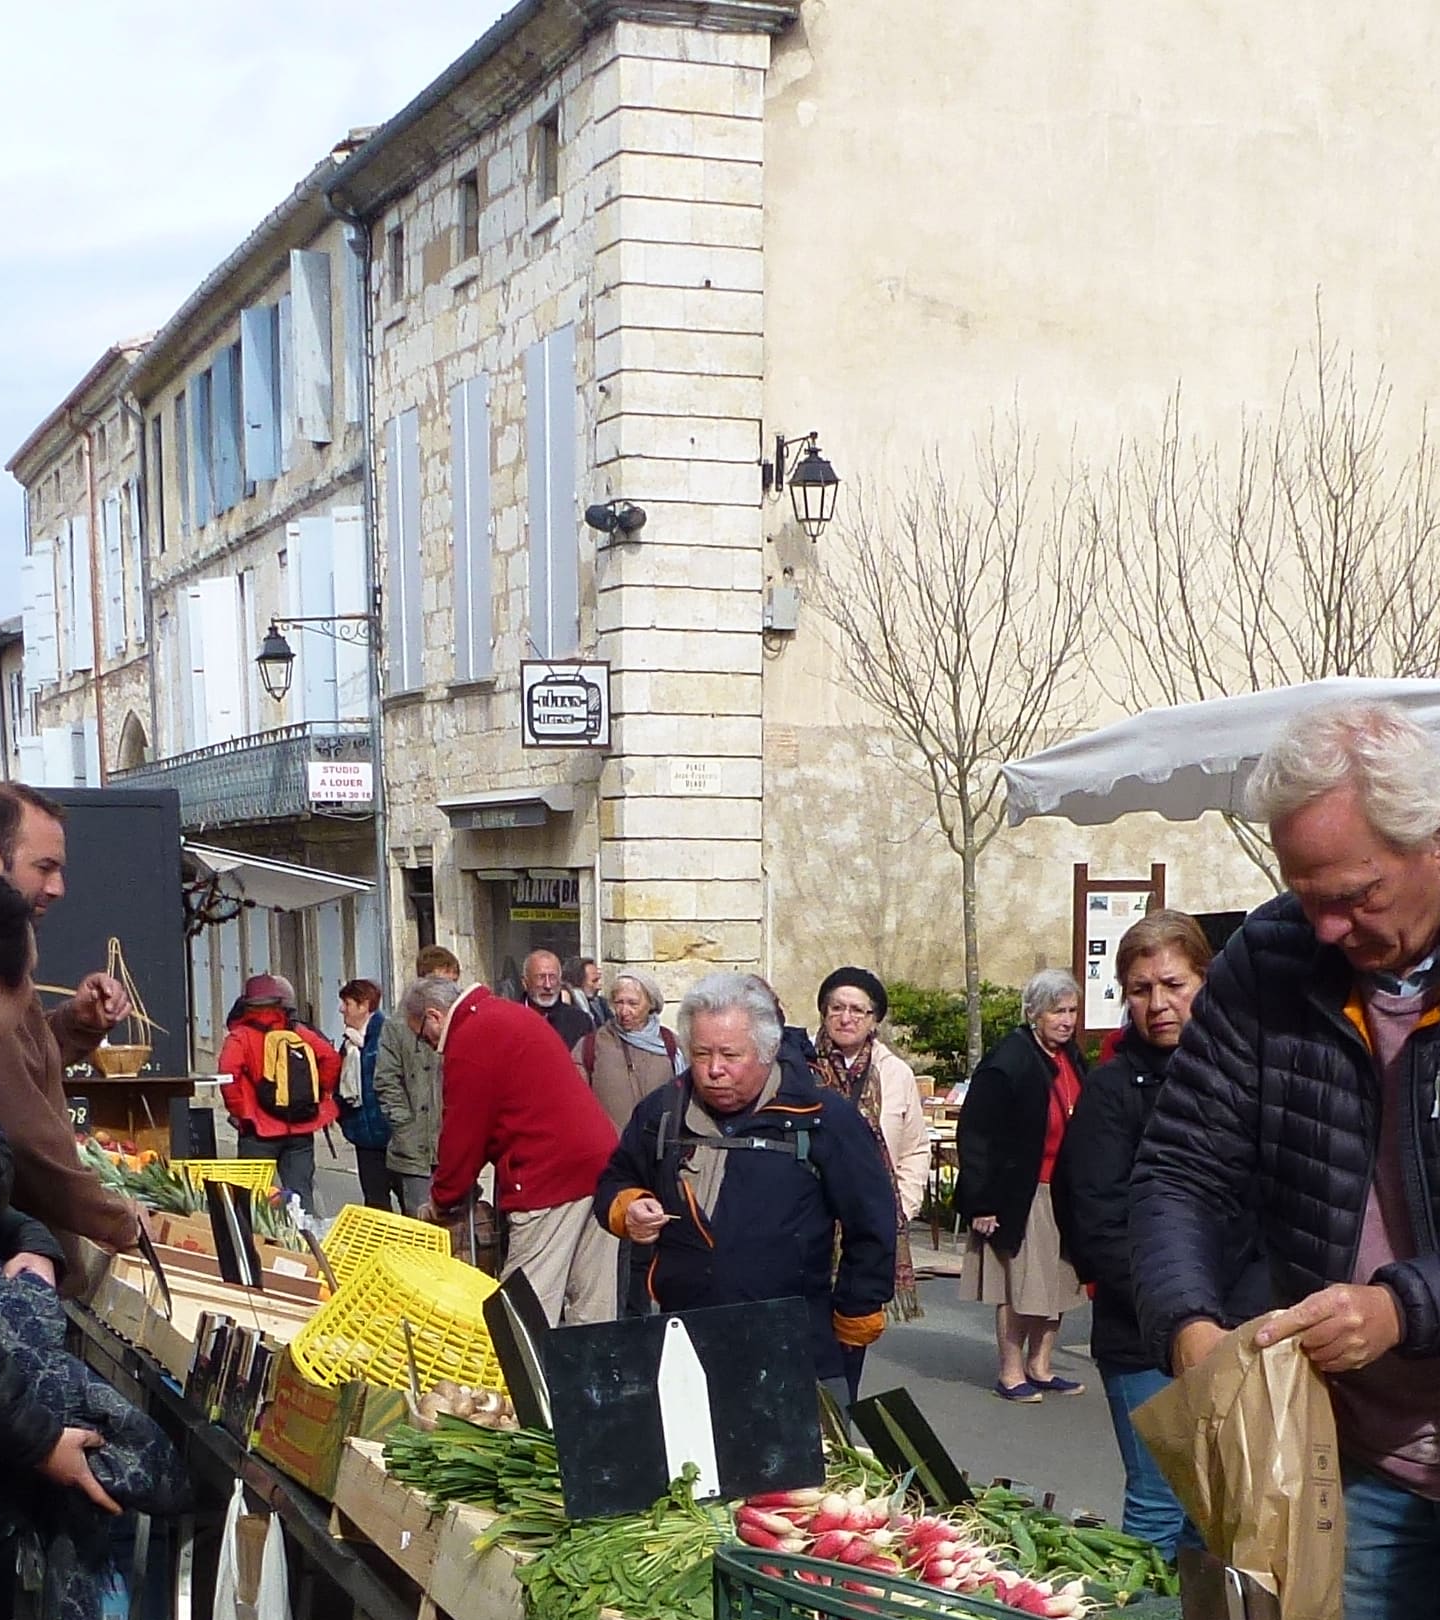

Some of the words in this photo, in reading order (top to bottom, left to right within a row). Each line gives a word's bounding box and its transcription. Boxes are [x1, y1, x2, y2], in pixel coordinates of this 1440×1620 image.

[322, 766, 360, 774] STUDIO
[320, 779, 326, 787] A
[329, 779, 363, 787] LOUER
[516, 880, 557, 903] BLANC
